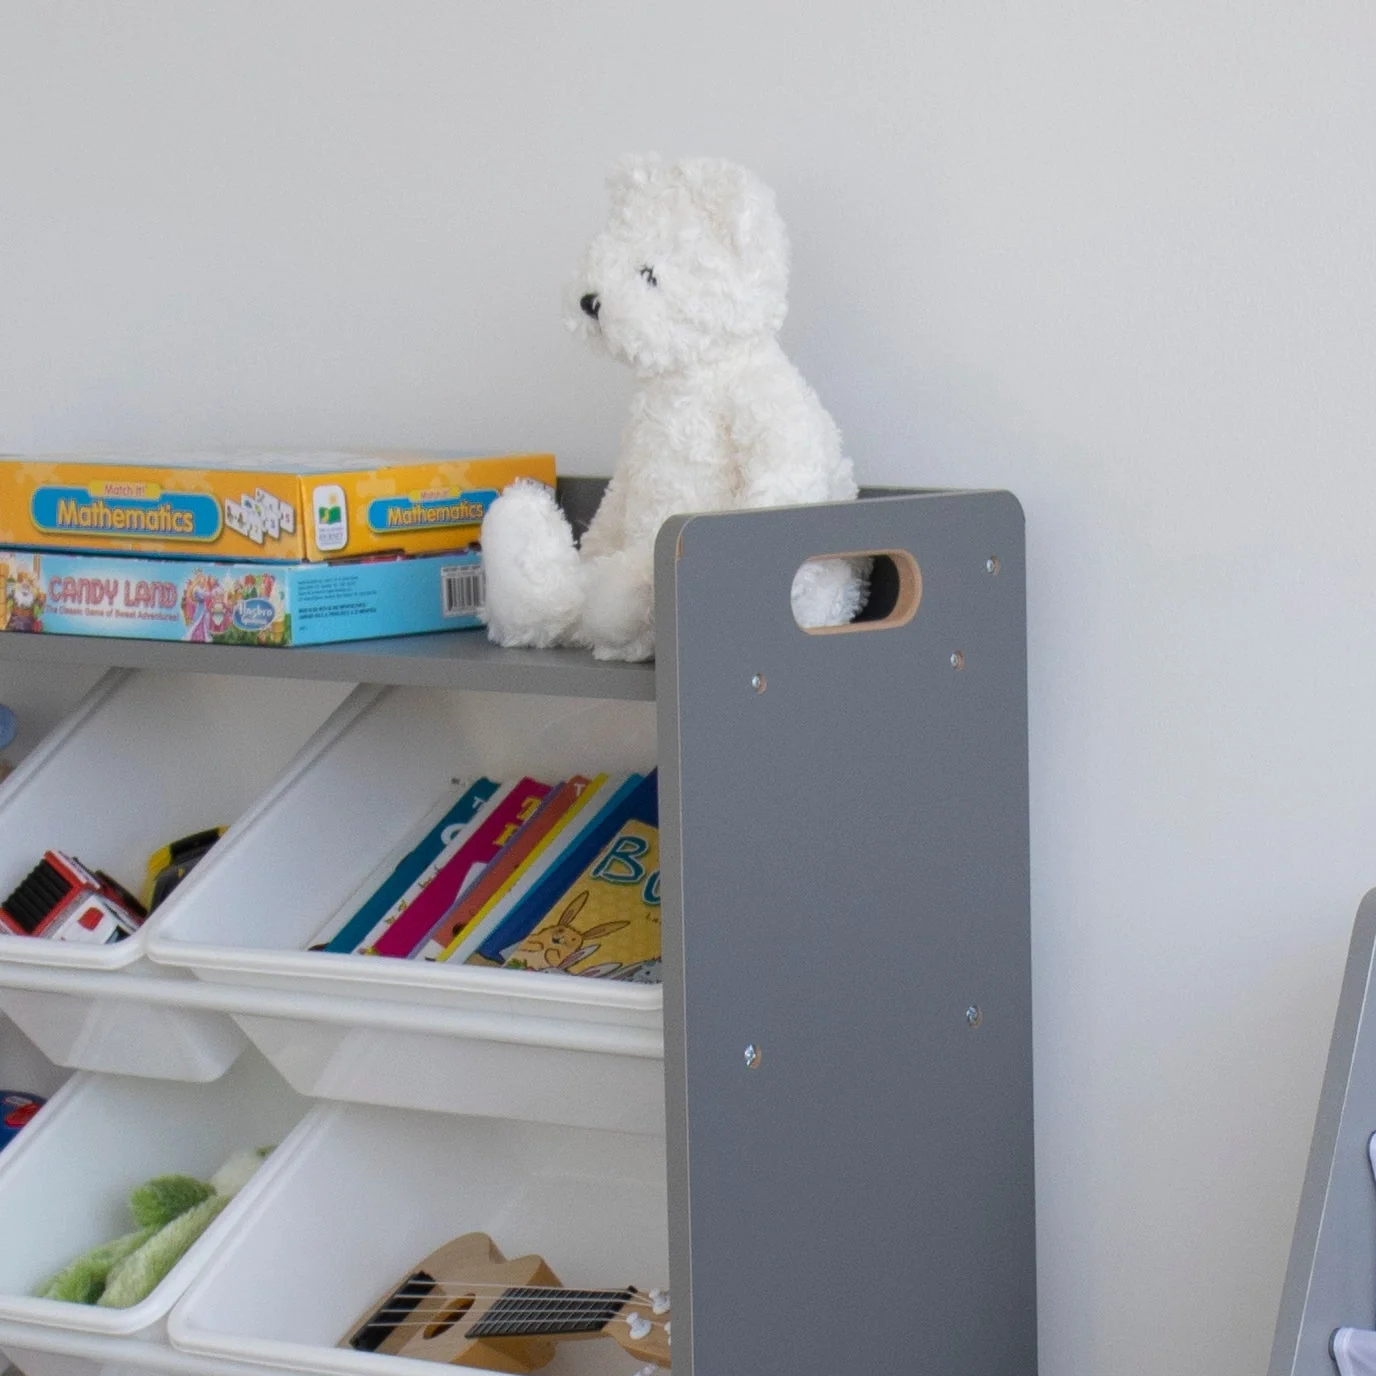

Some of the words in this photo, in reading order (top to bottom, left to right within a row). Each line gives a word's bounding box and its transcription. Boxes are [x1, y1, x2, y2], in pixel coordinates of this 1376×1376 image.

[57, 499, 194, 533] Mathematics
[387, 500, 484, 527] Mathematics
[48, 576, 118, 606] CANDY
[124, 579, 177, 609] LAND
